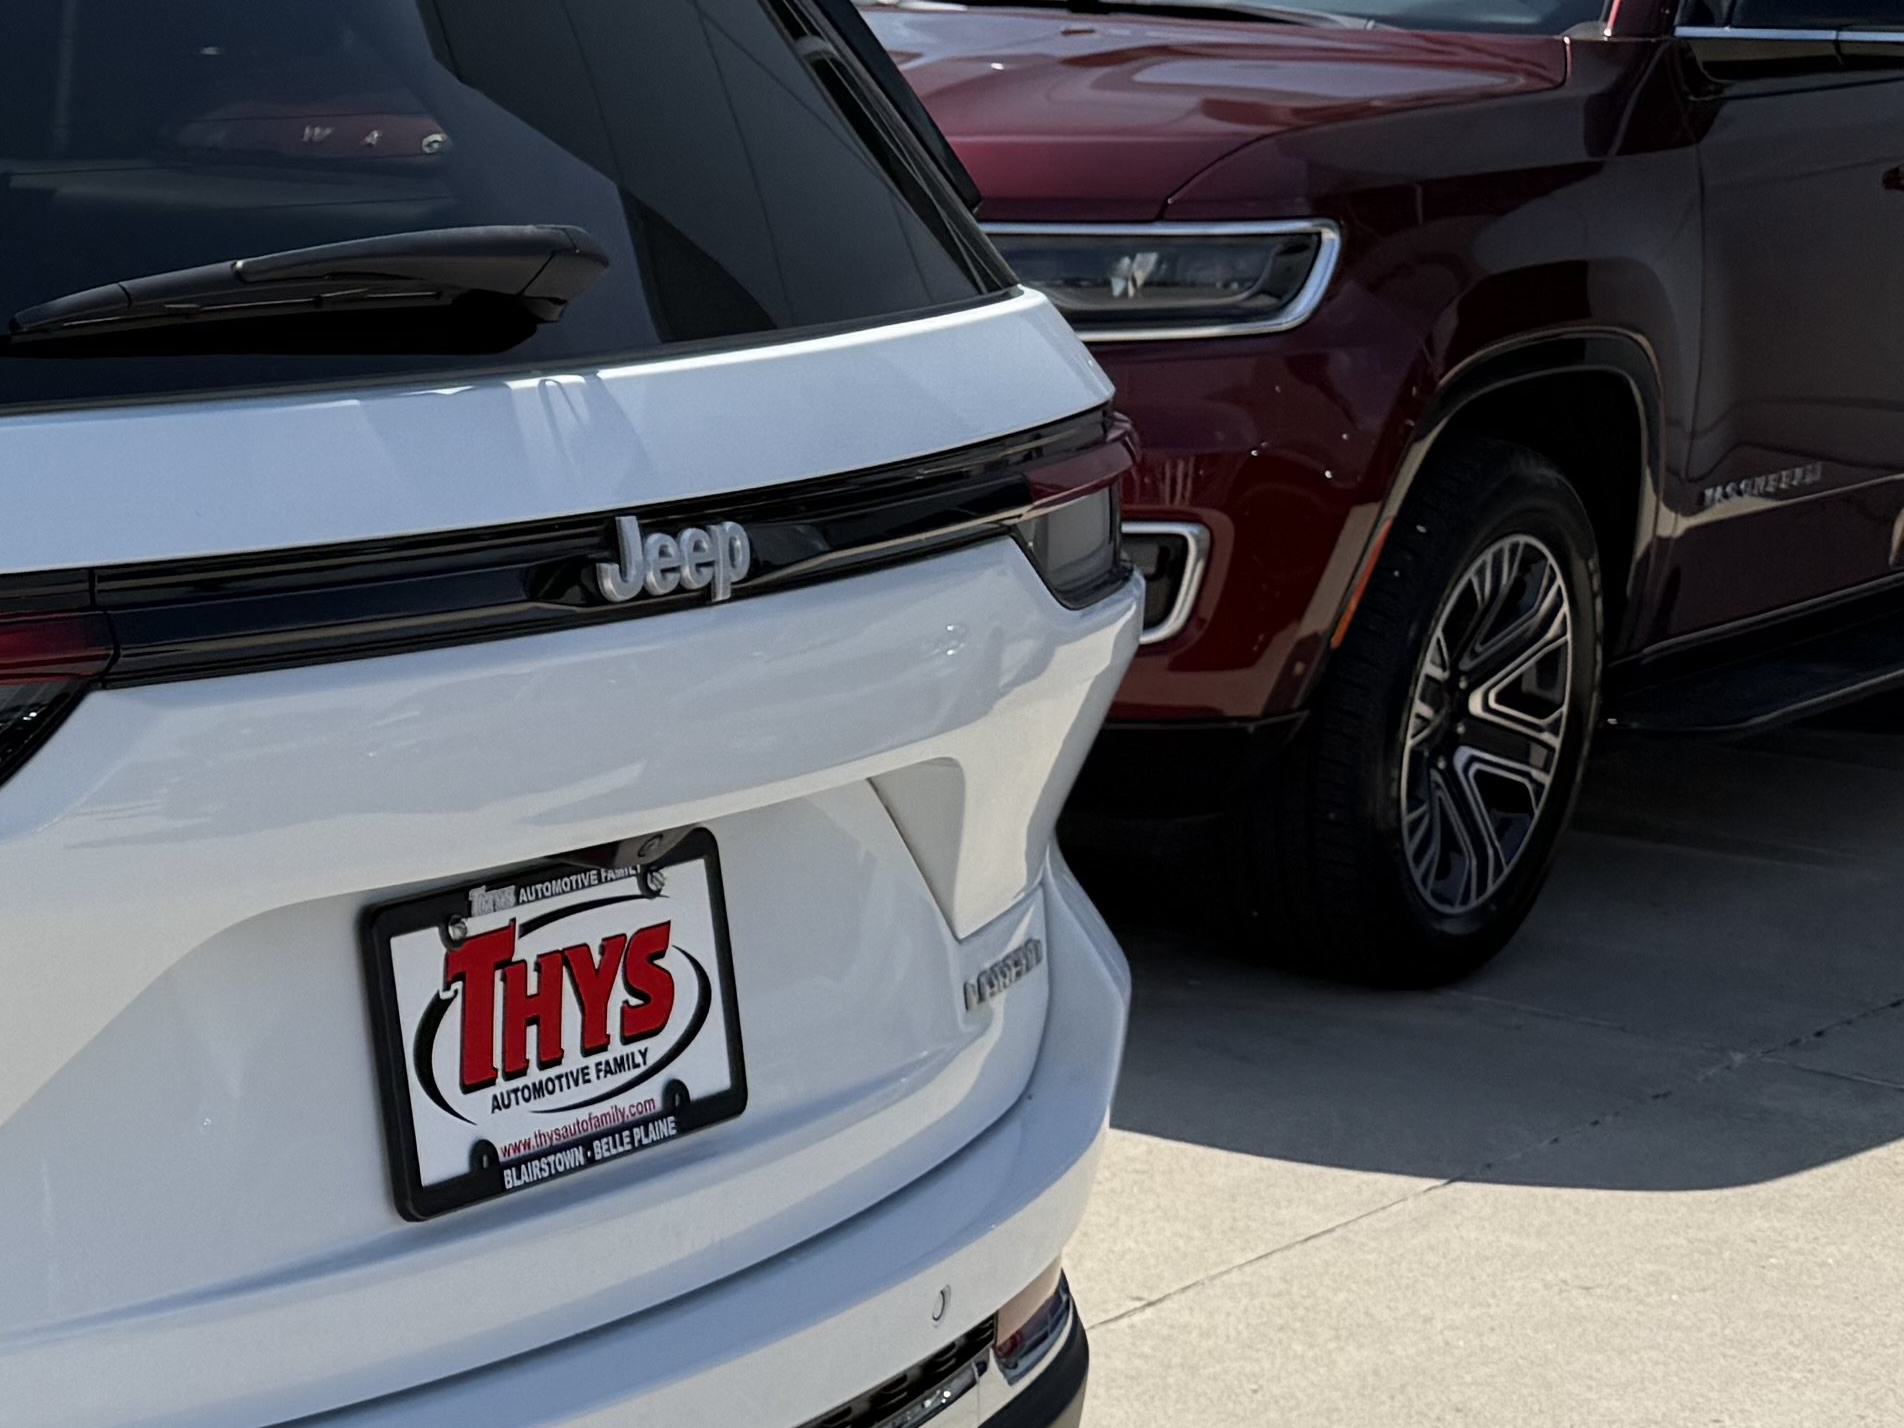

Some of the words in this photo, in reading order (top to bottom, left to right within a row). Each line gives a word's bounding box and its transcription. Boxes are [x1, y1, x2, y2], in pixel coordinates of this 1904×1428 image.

[595, 515, 751, 603] Jeep
[518, 869, 599, 904] AUTOMOTIVE
[444, 918, 675, 1095] THYS
[491, 1064, 592, 1115] AUTOMOTIVE
[594, 1046, 649, 1081] FAMILY
[500, 1097, 656, 1158] www.thysautofamily.com
[503, 1145, 585, 1190] BLAIRSTOWN
[592, 1129, 631, 1161] BELLE
[632, 1115, 678, 1148] PLAINE
